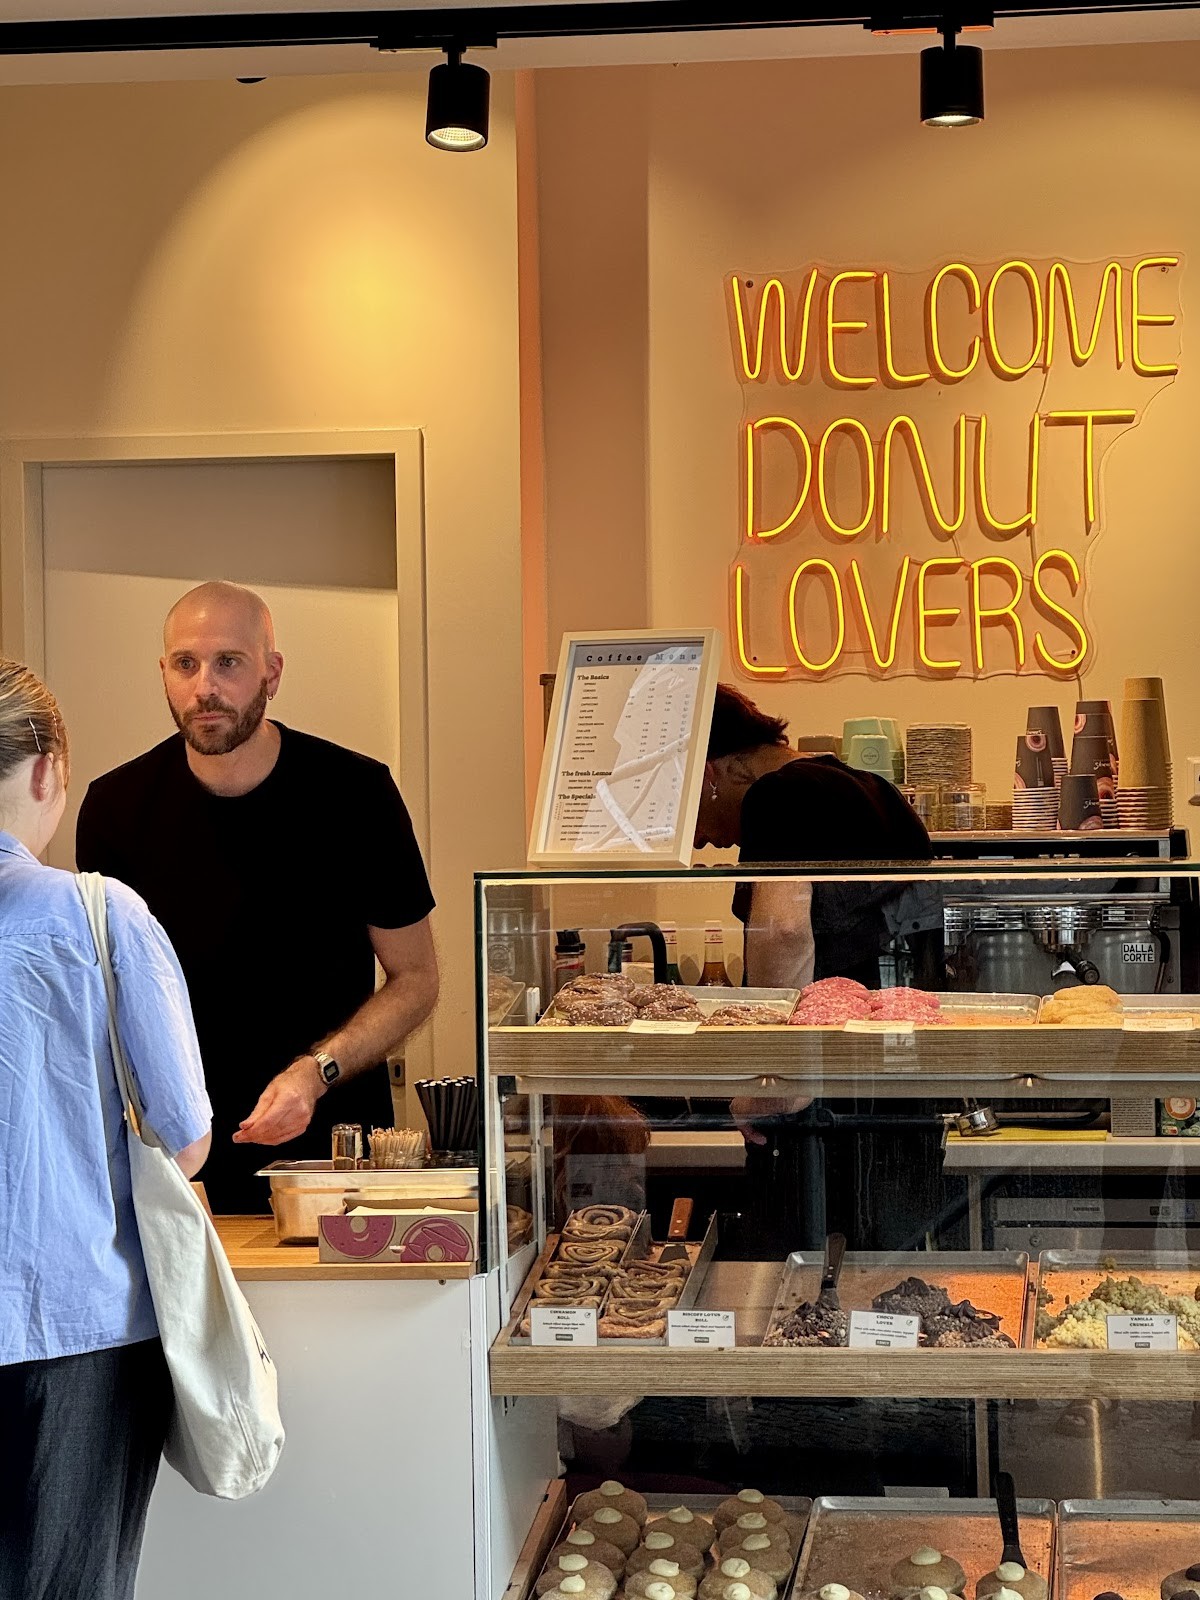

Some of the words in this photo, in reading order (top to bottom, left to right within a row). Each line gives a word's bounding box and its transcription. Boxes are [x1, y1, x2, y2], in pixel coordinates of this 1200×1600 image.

[731, 257, 1179, 383] WELCOME
[746, 408, 1136, 538] DONUT
[735, 548, 1088, 671] LOVERS
[586, 653, 642, 662] Coffee
[655, 653, 697, 661] Menu
[571, 793, 596, 801] Specials
[1123, 944, 1154, 953] DALLA
[1123, 953, 1154, 962] CORTE
